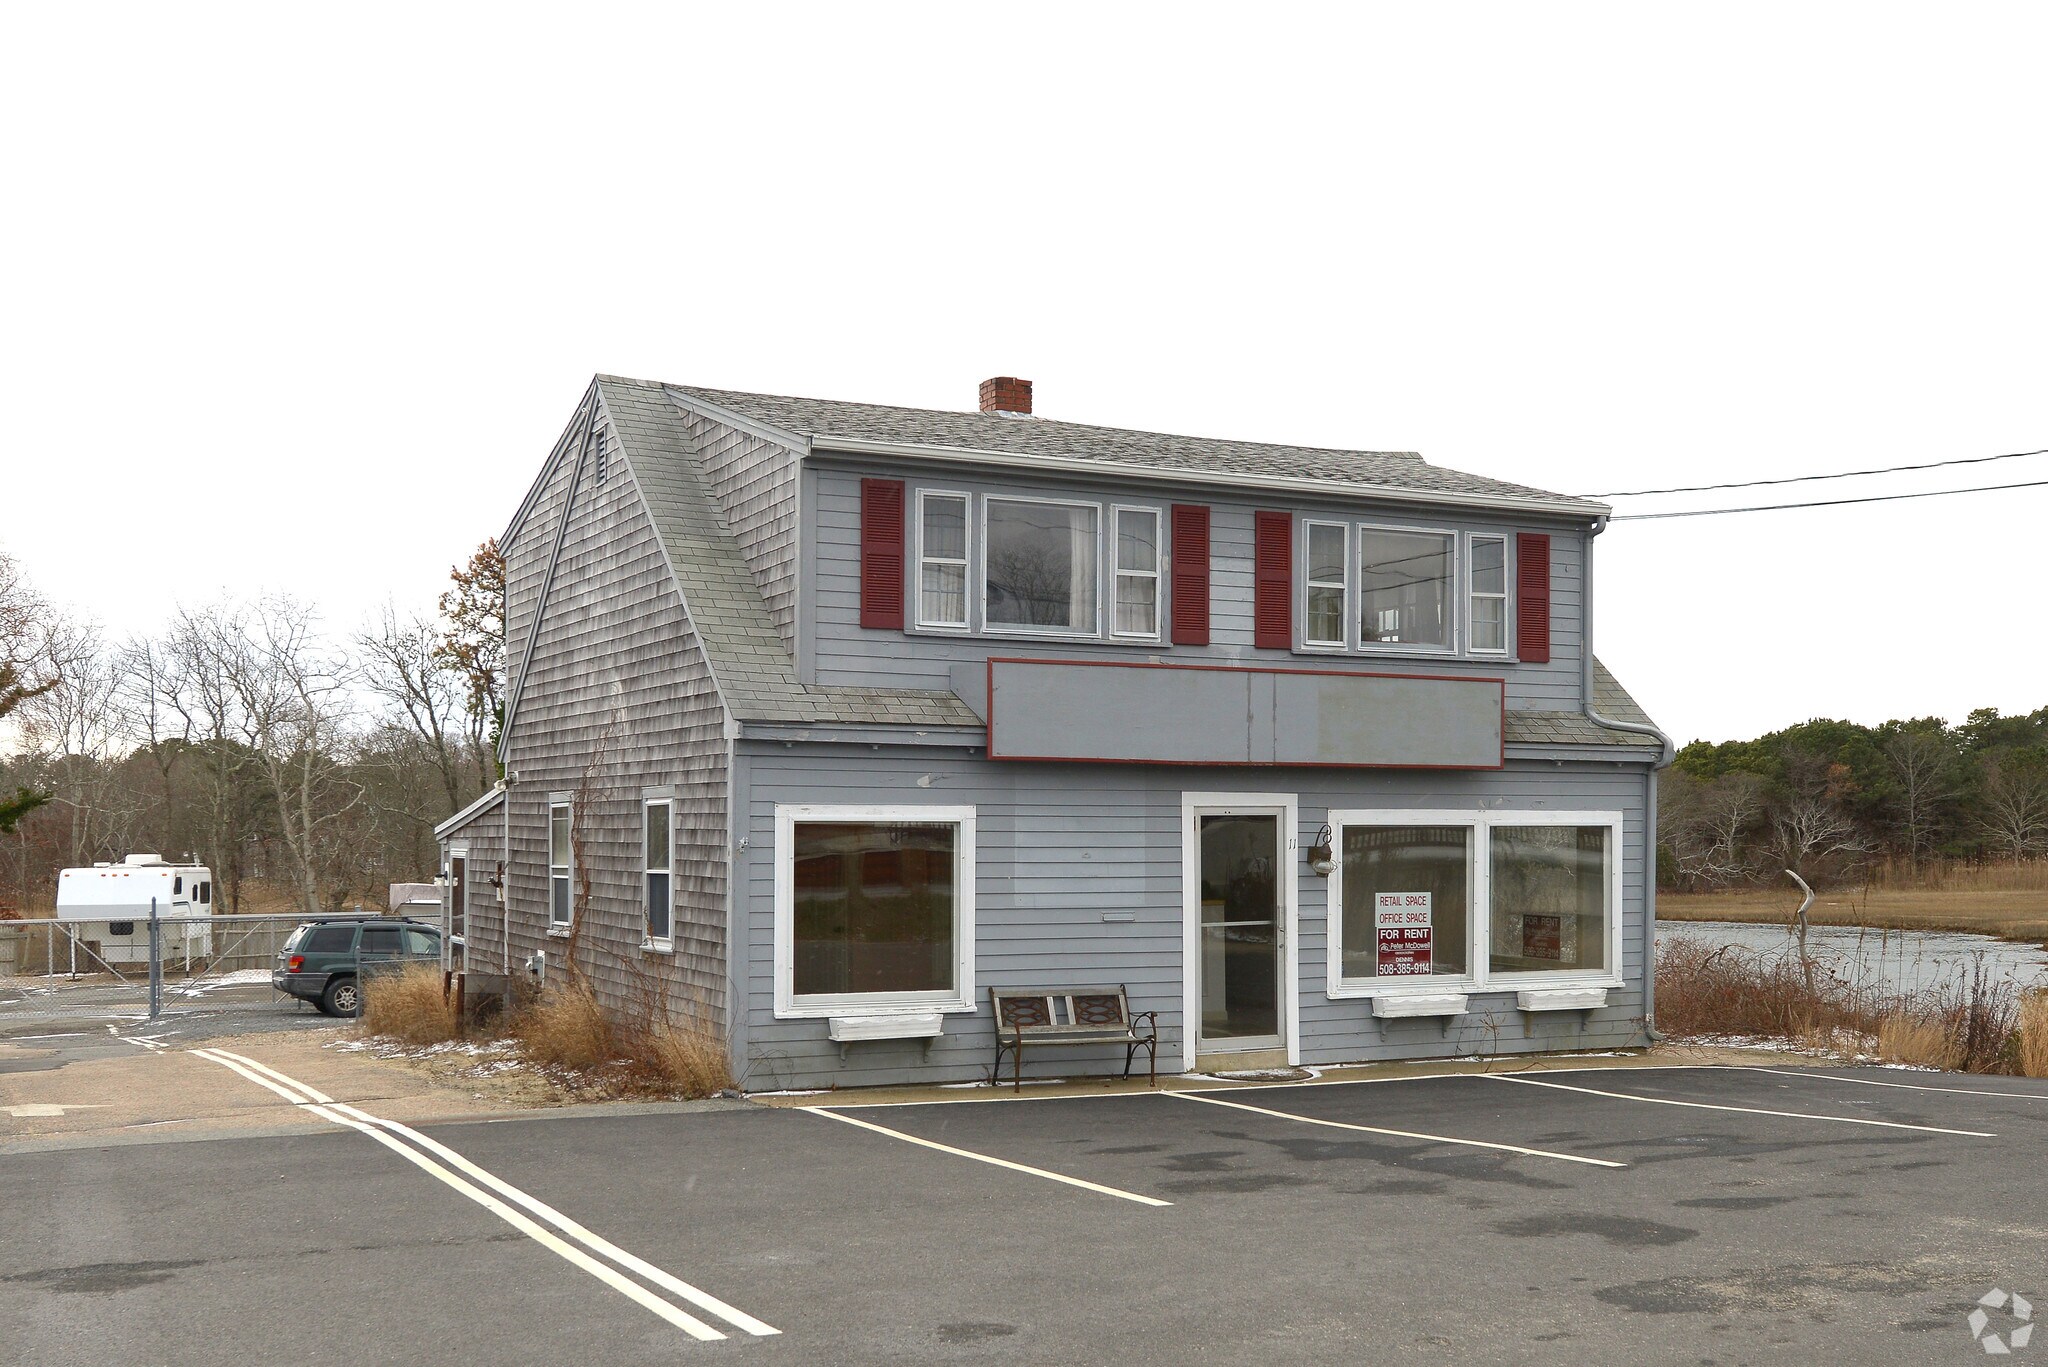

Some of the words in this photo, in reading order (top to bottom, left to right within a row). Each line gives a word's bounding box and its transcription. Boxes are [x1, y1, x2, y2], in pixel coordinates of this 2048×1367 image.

[1288, 838, 1297, 850] 11
[1380, 896, 1402, 906] RETAIL
[1405, 895, 1427, 906] SPACE
[1379, 913, 1403, 924] OFFICE
[1406, 912, 1427, 923] SPACE
[1525, 916, 1537, 926] FOR
[1541, 917, 1559, 927] RENT
[1380, 929, 1399, 940] FOR
[1404, 928, 1429, 939] RENT
[1379, 963, 1430, 975] 508-385-9114
